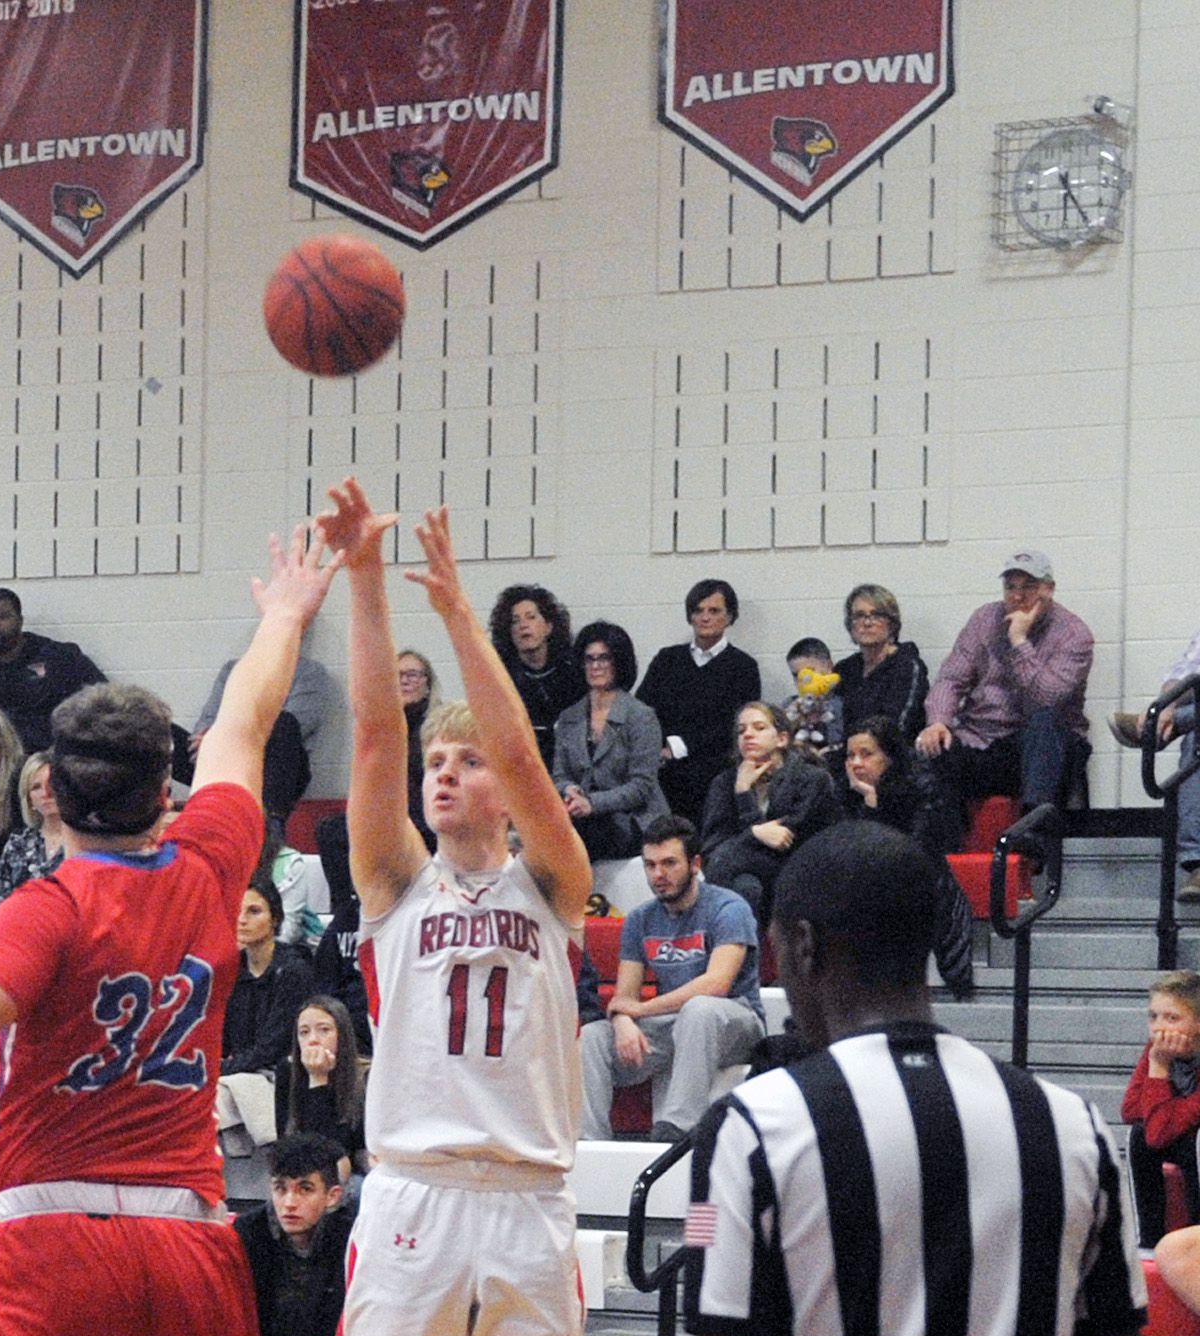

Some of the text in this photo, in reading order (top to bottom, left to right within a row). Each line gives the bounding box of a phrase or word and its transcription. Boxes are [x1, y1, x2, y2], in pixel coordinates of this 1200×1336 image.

[682, 52, 935, 107] ALLENTOWN
[311, 90, 541, 143] ALLENTOWN
[419, 908, 540, 961] REDBIRDS
[54, 953, 214, 1094] 32
[446, 963, 509, 1057] 11
